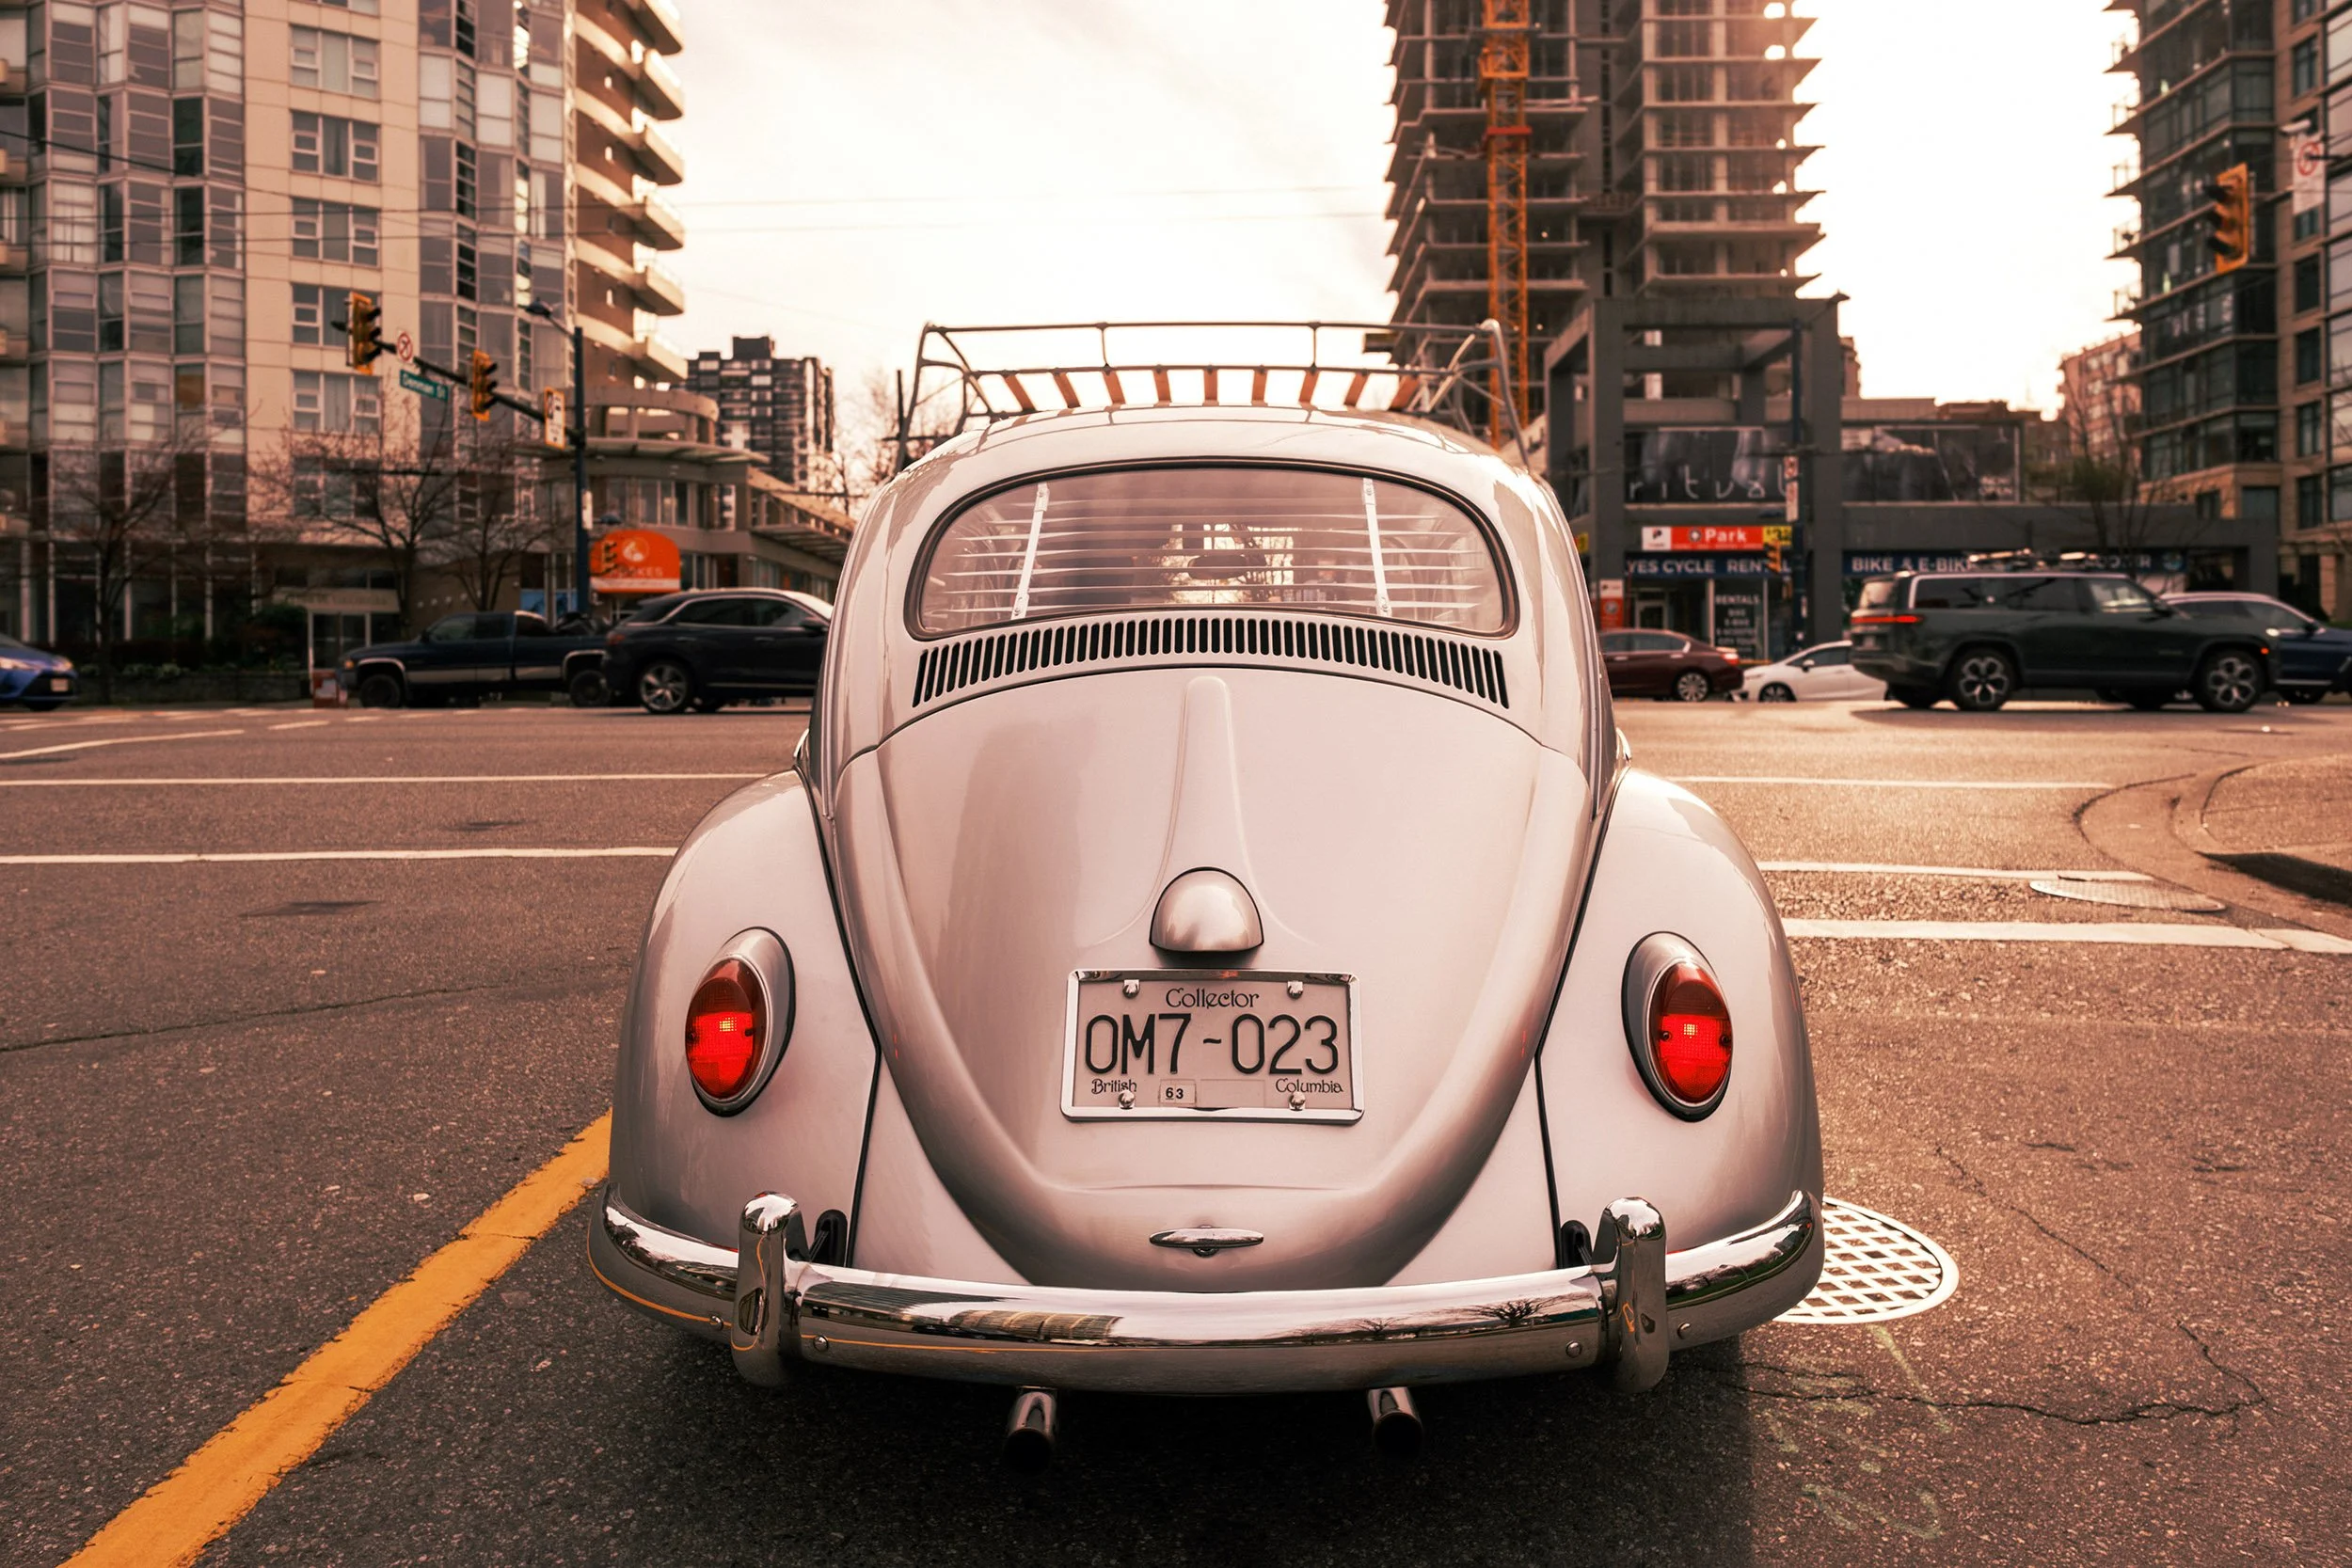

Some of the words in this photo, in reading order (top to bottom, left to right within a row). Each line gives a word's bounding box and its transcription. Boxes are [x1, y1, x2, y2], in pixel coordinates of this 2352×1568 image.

[1705, 528, 1747, 543] Park
[1628, 559, 1659, 574] YES
[1662, 558, 1716, 574] CYCLE
[1851, 557, 1894, 573] BIKE
[1166, 988, 1260, 1009] Collector
[1091, 1078, 1137, 1095] British
[1276, 1078, 1343, 1094] Columbia
[1166, 1087, 1184, 1100] 63
